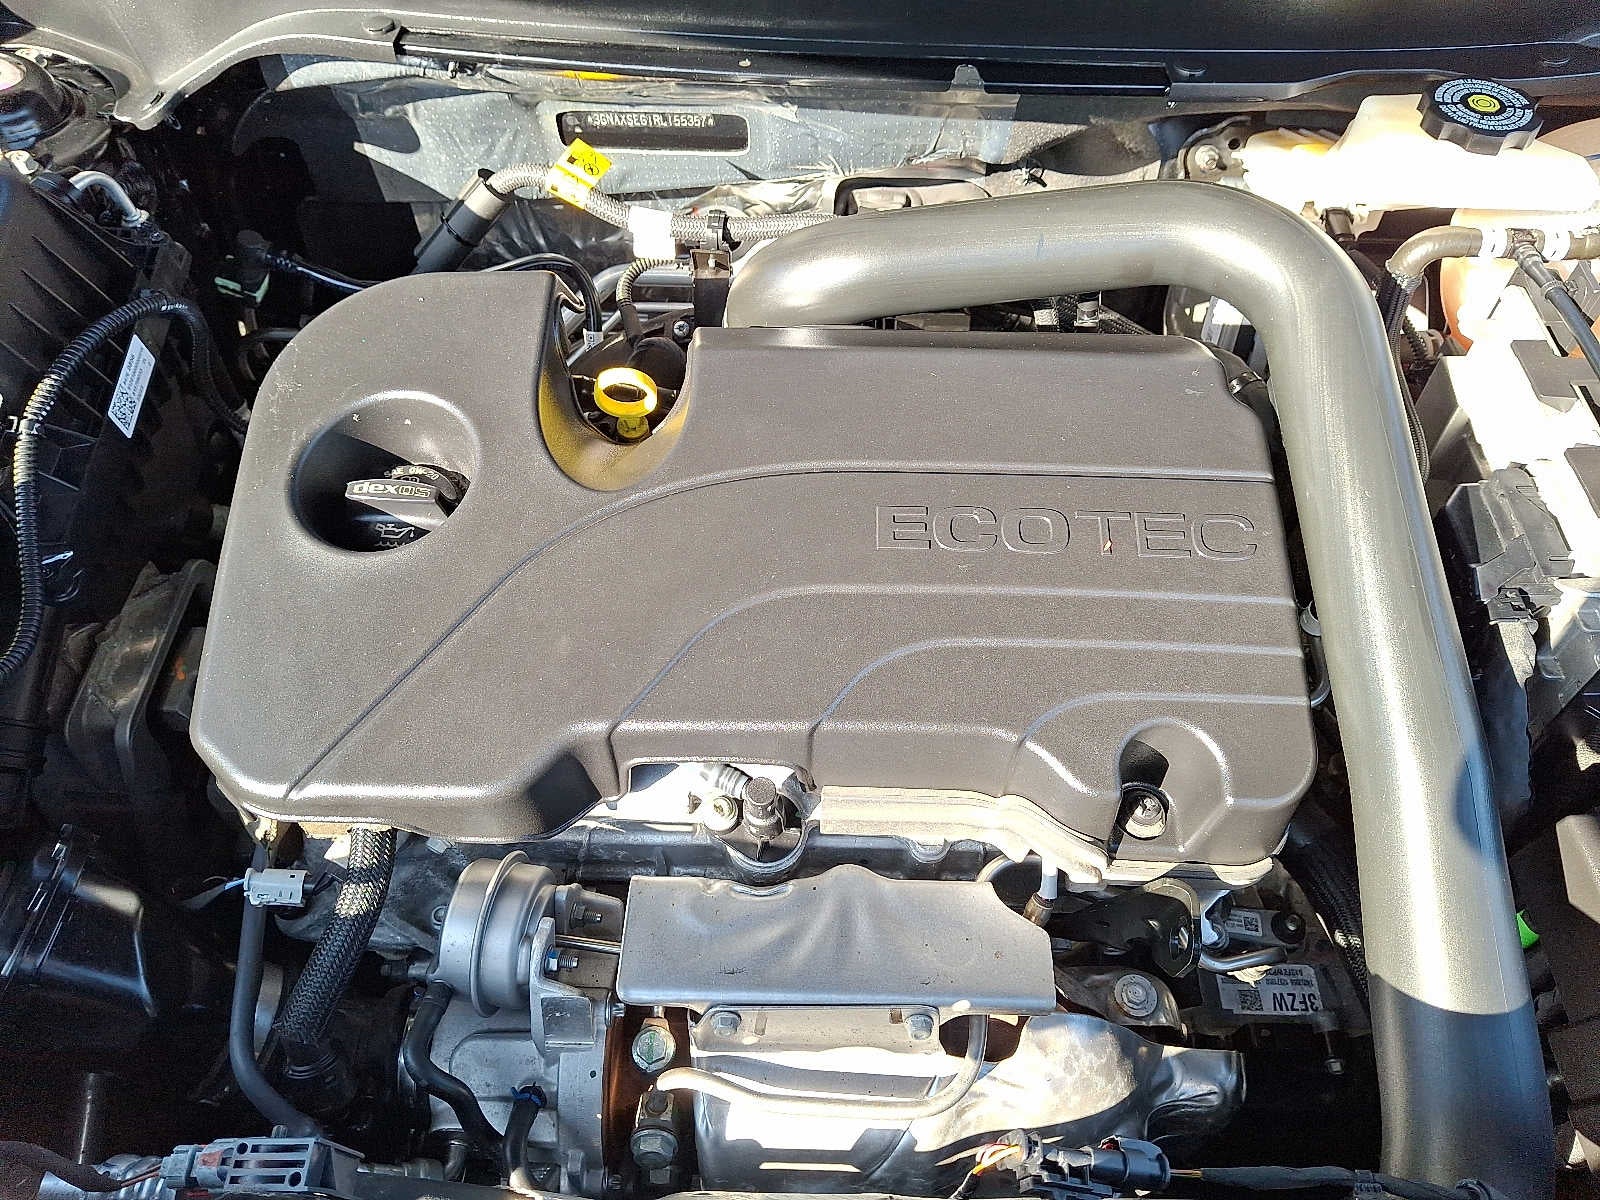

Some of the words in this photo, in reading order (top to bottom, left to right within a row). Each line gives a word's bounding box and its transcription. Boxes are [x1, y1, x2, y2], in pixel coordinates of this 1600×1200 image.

[352, 482, 431, 498] dexos
[876, 504, 1258, 562] ECOTEC
[1272, 992, 1320, 1012] 3FZW
